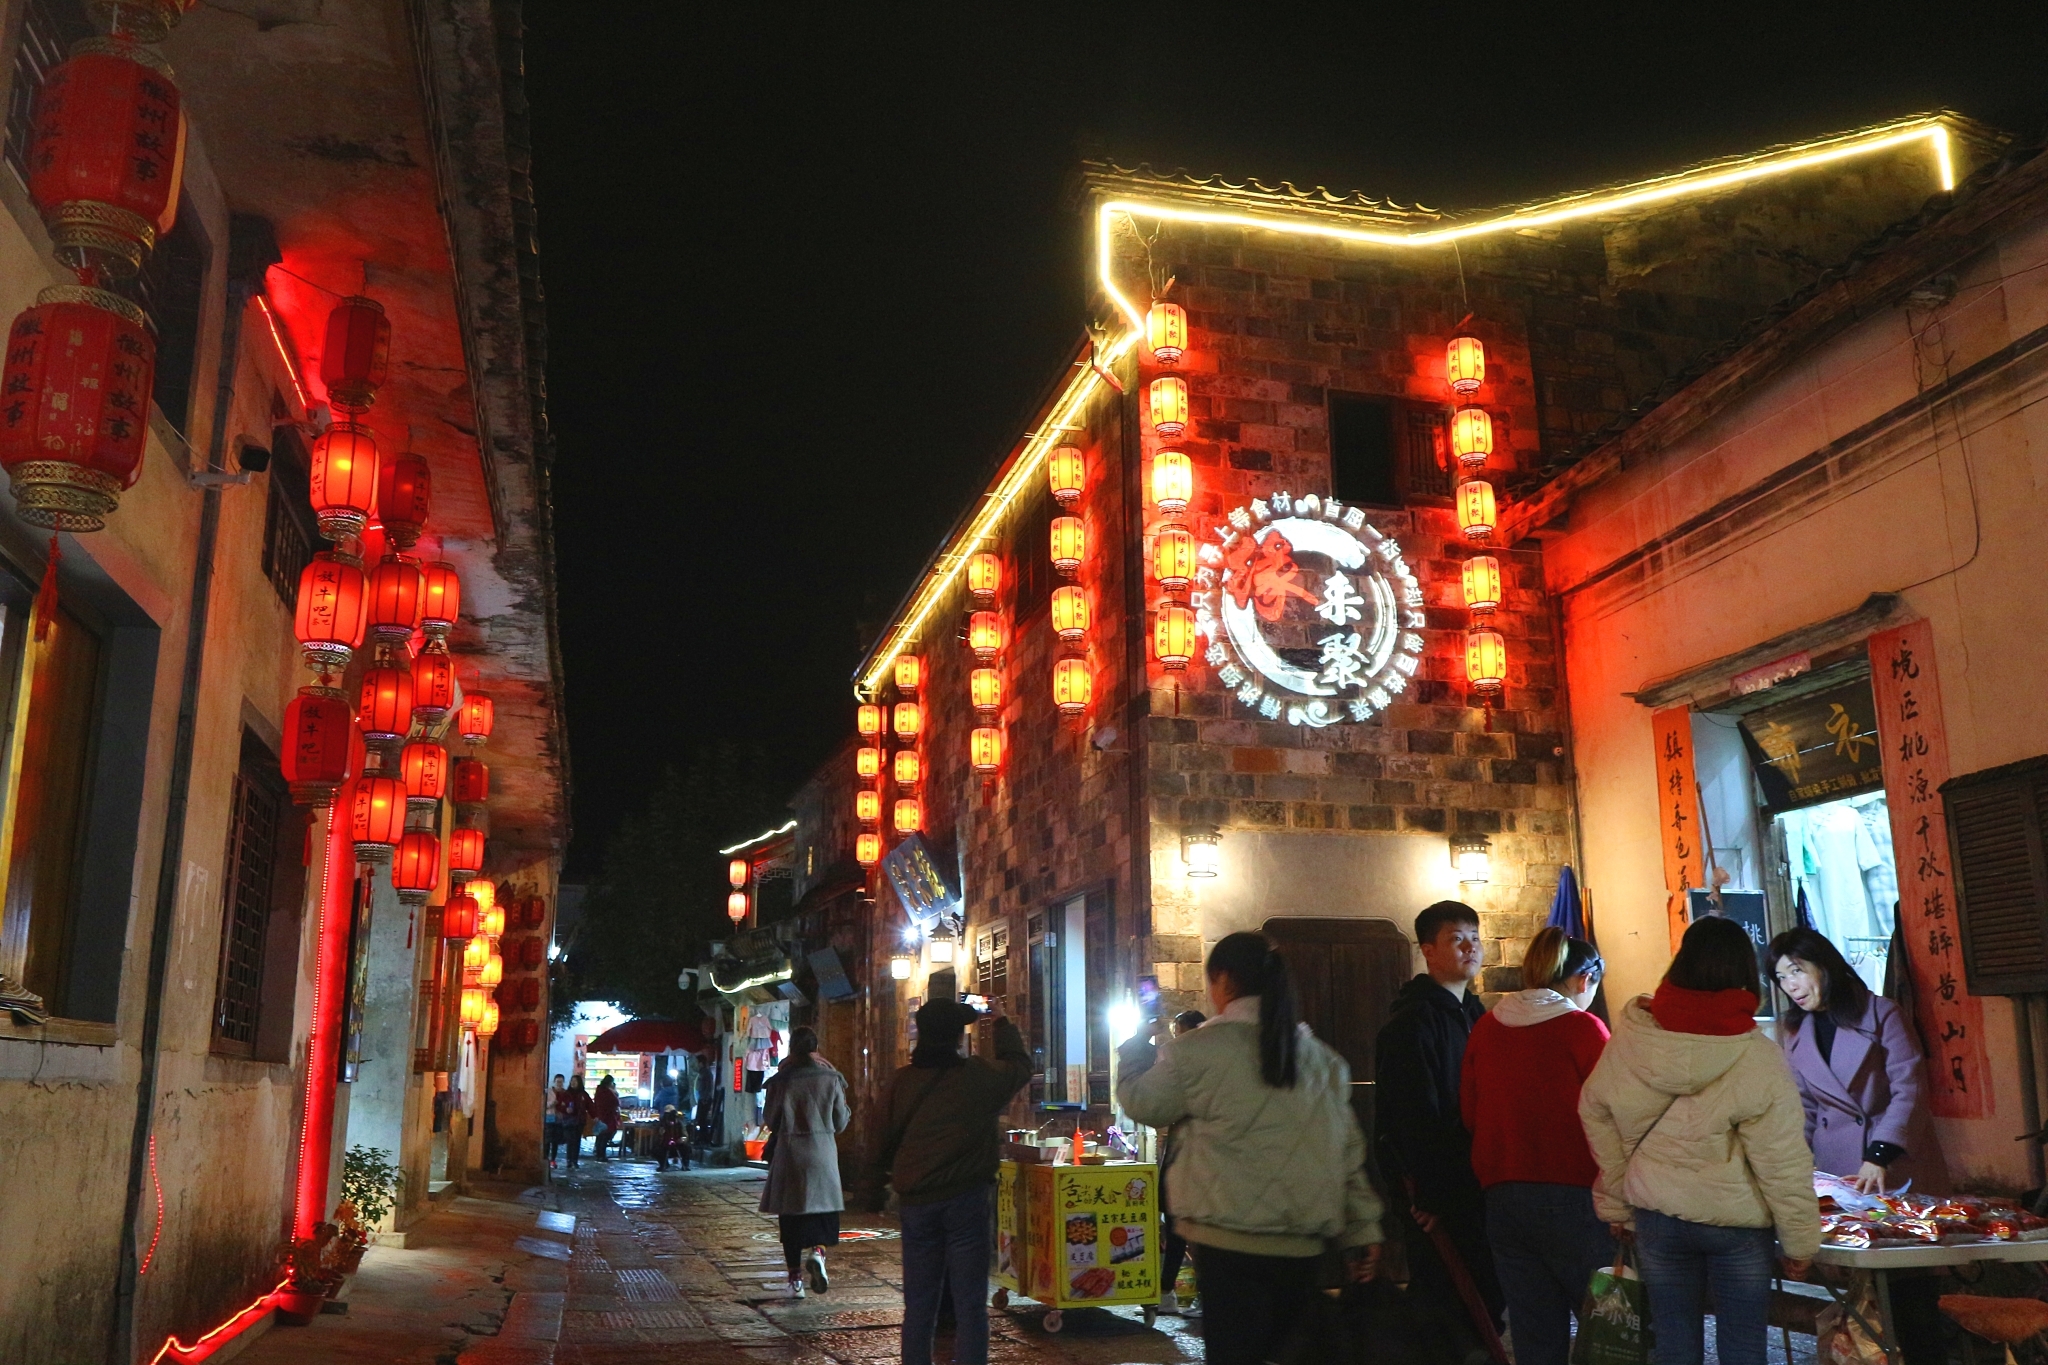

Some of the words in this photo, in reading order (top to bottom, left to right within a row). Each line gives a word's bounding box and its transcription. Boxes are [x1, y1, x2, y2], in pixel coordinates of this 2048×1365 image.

[132, 79, 177, 181] 徽州故事
[4, 315, 43, 428] 徽州故事
[106, 333, 148, 443] 徽州故事
[1323, 496, 1402, 564] 首屈一指
[312, 570, 337, 617] 放牛吧
[362, 678, 375, 714] 放牛吧
[435, 661, 448, 692] 放牛吧
[1204, 641, 1282, 721] 精挑细选
[301, 706, 323, 755] 放牛吧
[424, 749, 438, 782] 放牛吧
[354, 783, 370, 822] 放牛吧
[1062, 1177, 1122, 1205] 舌尖上的美食
[1101, 1212, 1148, 1224] 正宗毛豆腐
